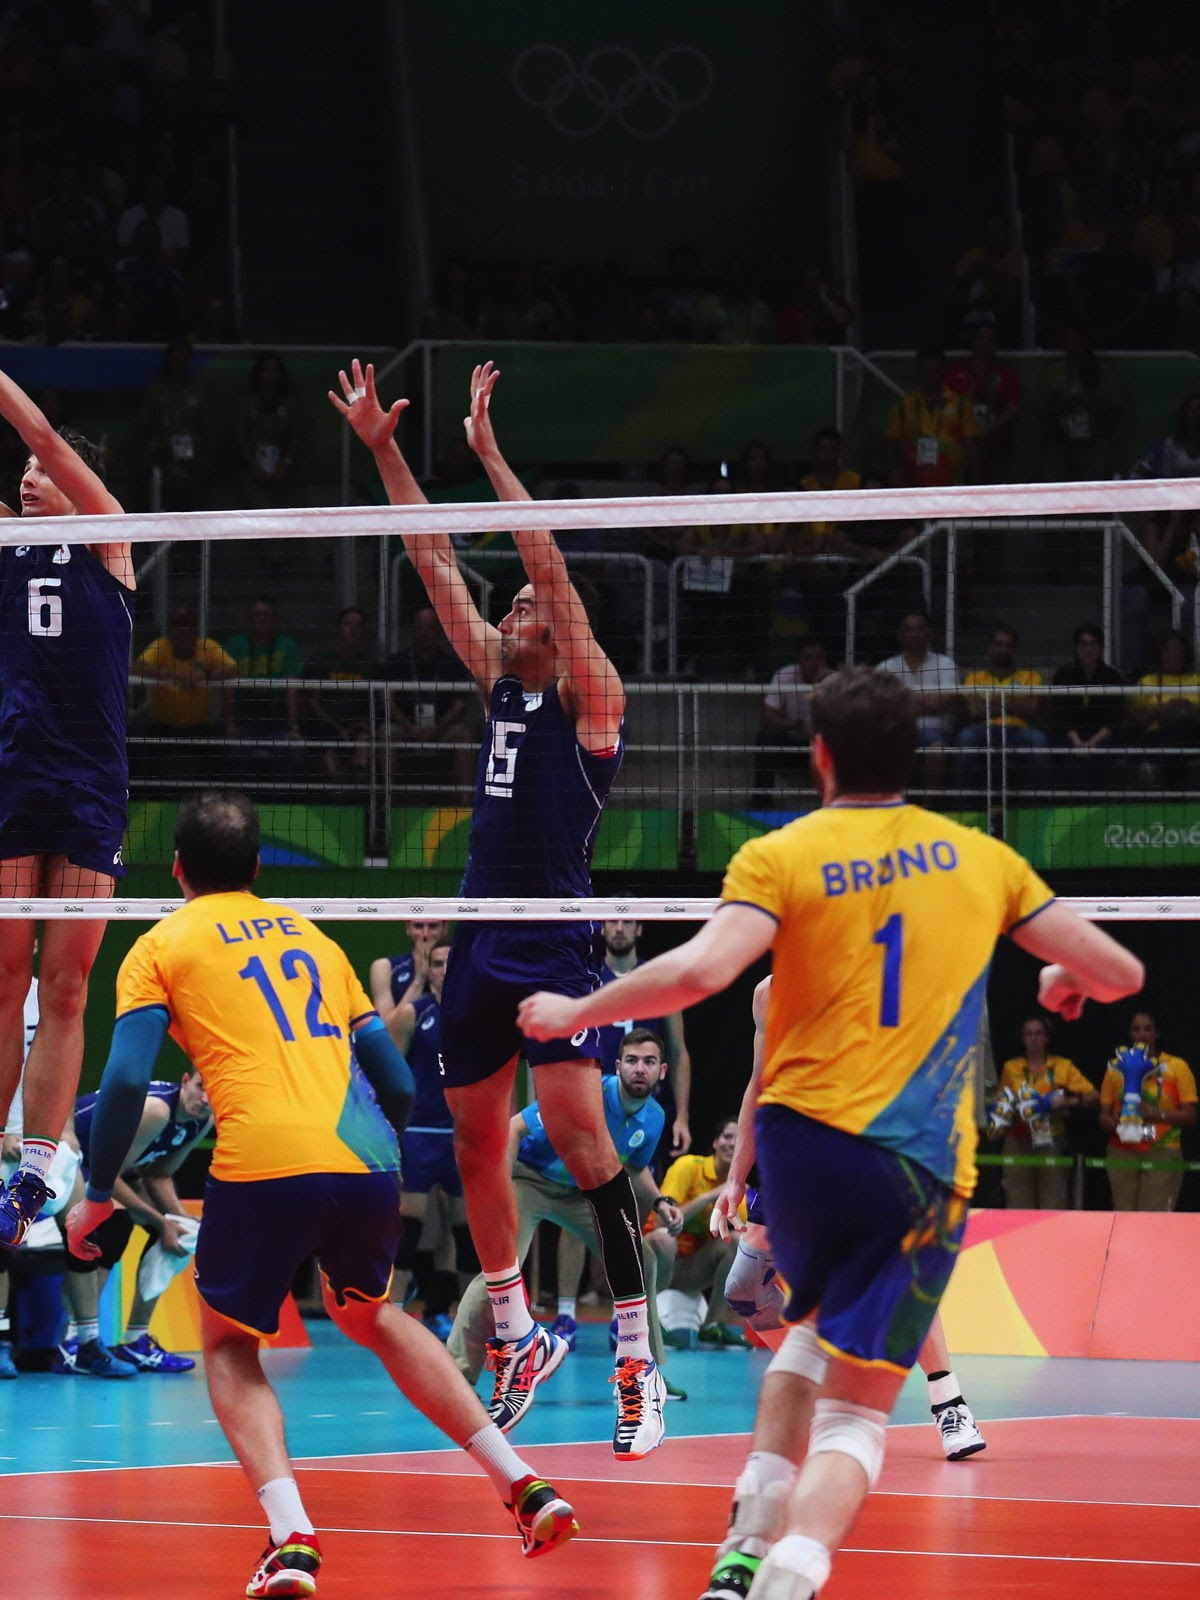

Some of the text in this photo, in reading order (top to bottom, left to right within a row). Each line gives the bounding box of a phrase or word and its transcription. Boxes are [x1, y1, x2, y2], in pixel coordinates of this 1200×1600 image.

[28, 578, 62, 637] 6
[485, 720, 527, 784] 15
[215, 917, 303, 944] LIPE
[238, 949, 342, 1042] 12
[872, 912, 903, 1027] 1
